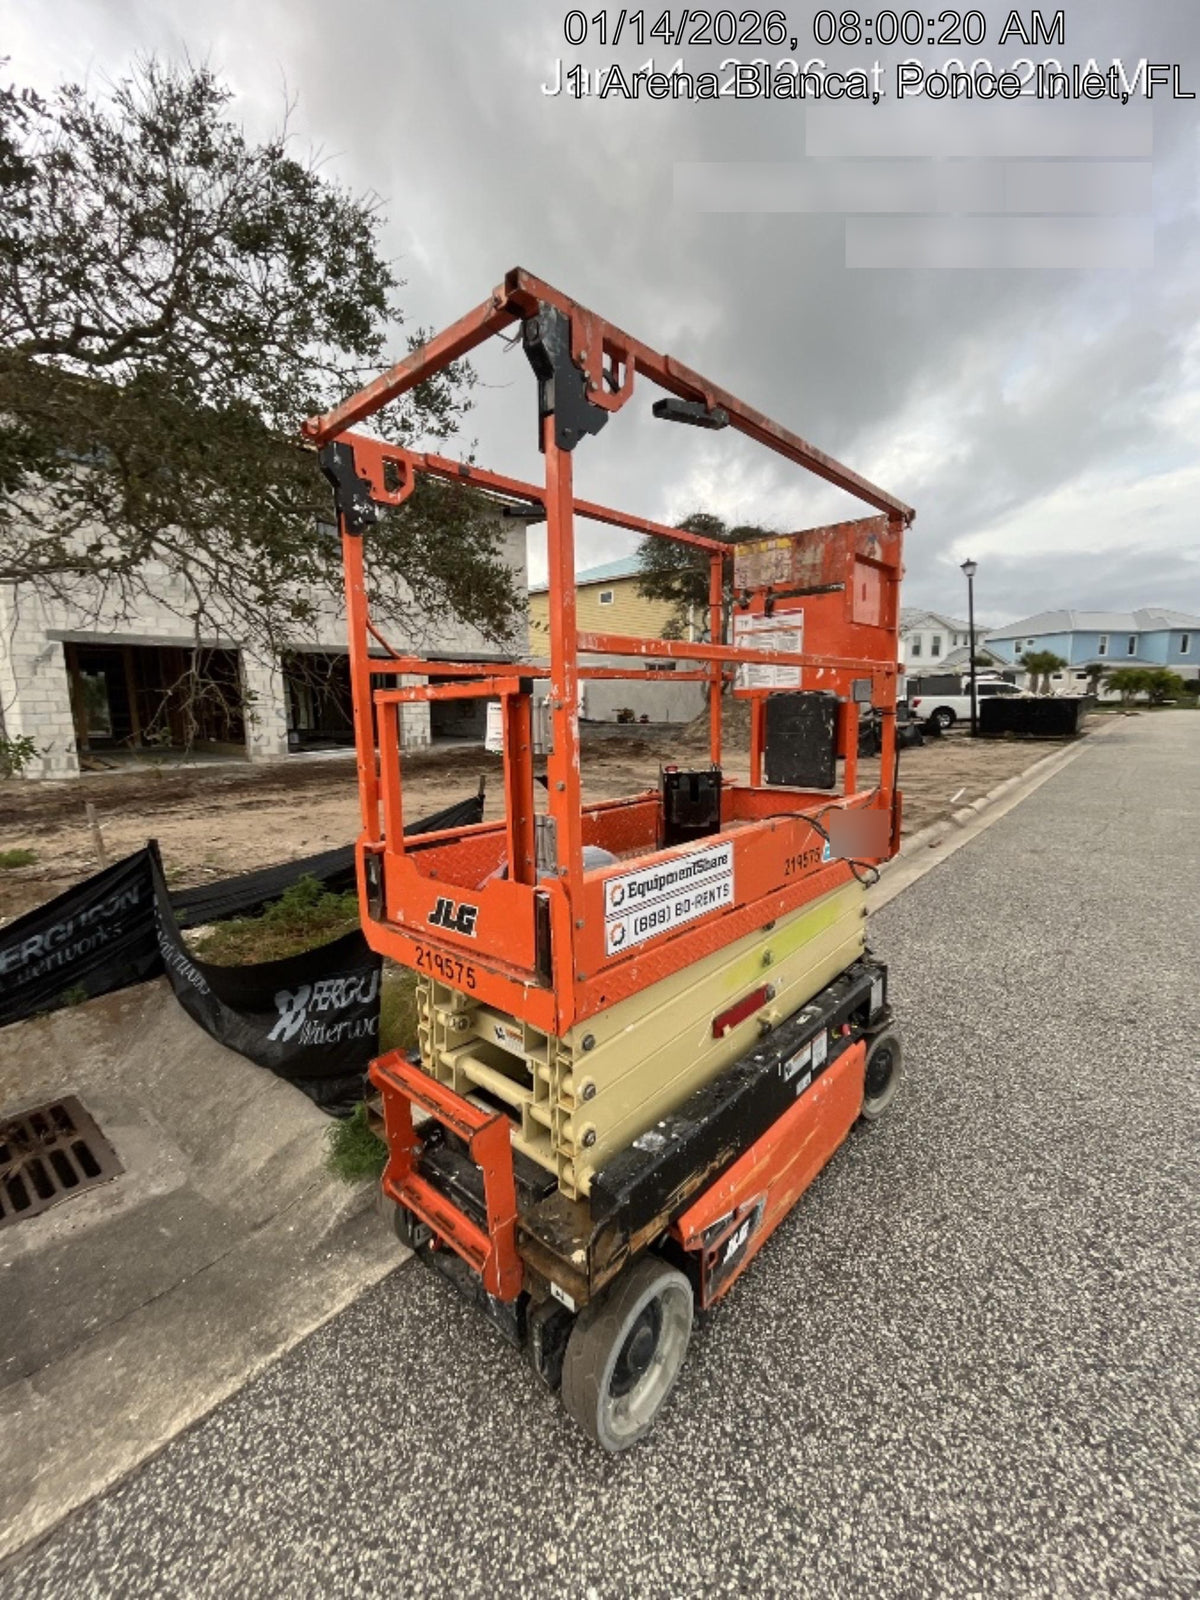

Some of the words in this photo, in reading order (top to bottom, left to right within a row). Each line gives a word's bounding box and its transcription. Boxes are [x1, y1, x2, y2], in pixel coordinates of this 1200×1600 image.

[627, 854, 728, 900] EquipmentShare
[784, 846, 820, 877] 219575
[427, 896, 478, 937] JLG
[634, 905, 671, 936] (888)
[415, 945, 476, 990] 219575
